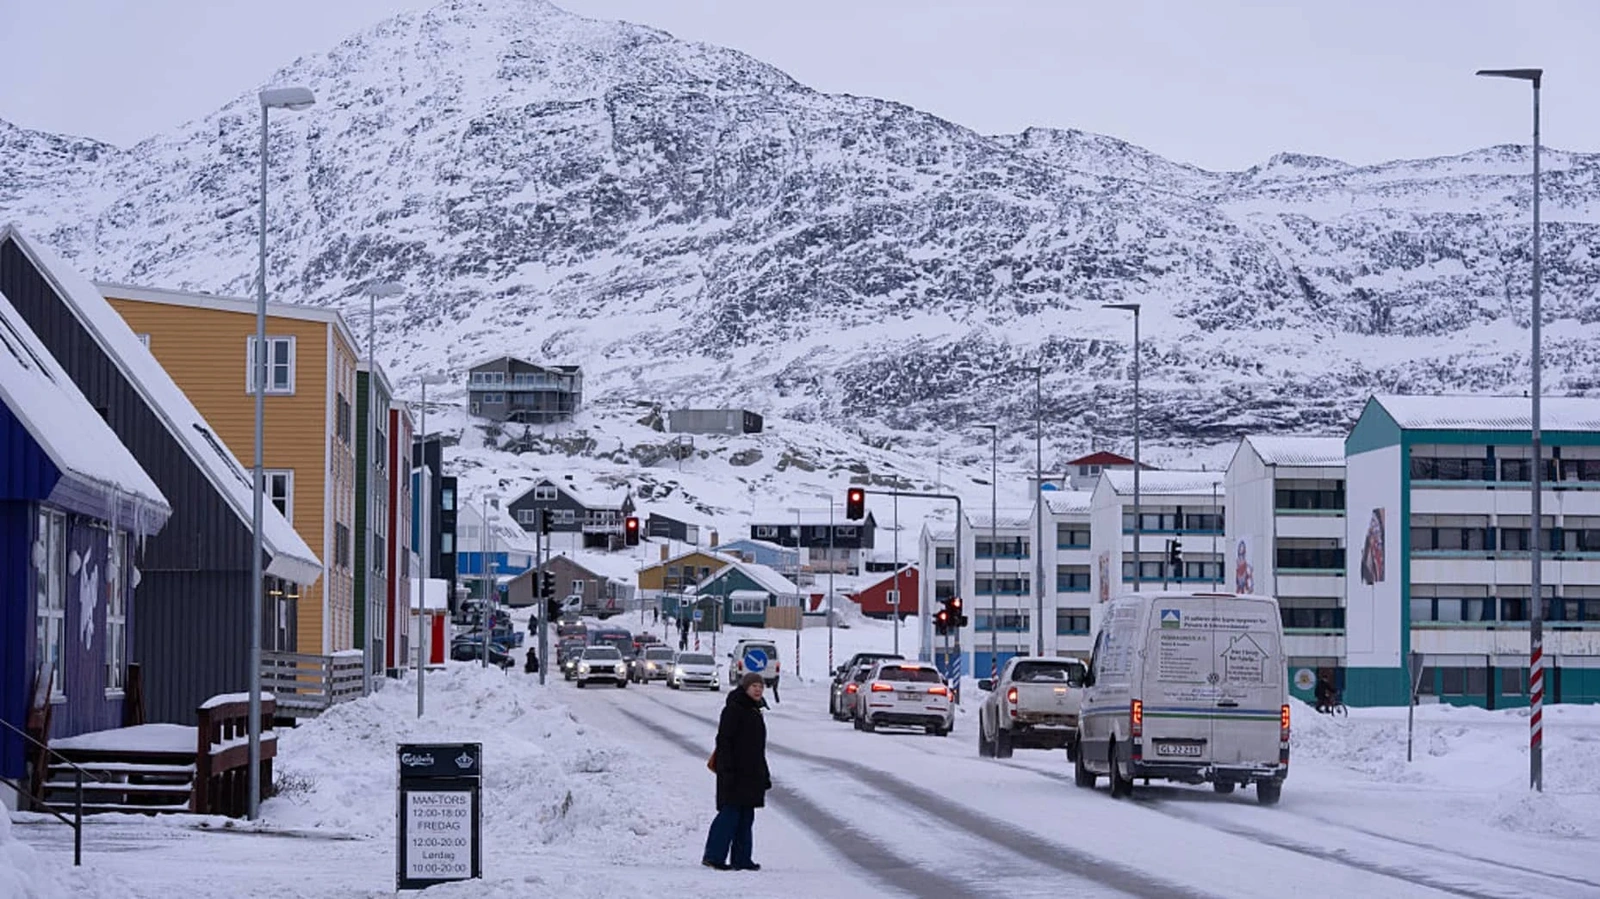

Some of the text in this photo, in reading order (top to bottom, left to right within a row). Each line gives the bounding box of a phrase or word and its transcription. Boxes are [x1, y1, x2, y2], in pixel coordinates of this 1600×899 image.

[412, 796, 466, 805] MAN-TORS
[413, 808, 467, 817] 12:00-18:00
[417, 821, 461, 830] FREDAG
[413, 838, 467, 847] 12:00-20:00
[422, 851, 455, 861] Lørdag
[412, 863, 467, 872] 10:00-20:00
